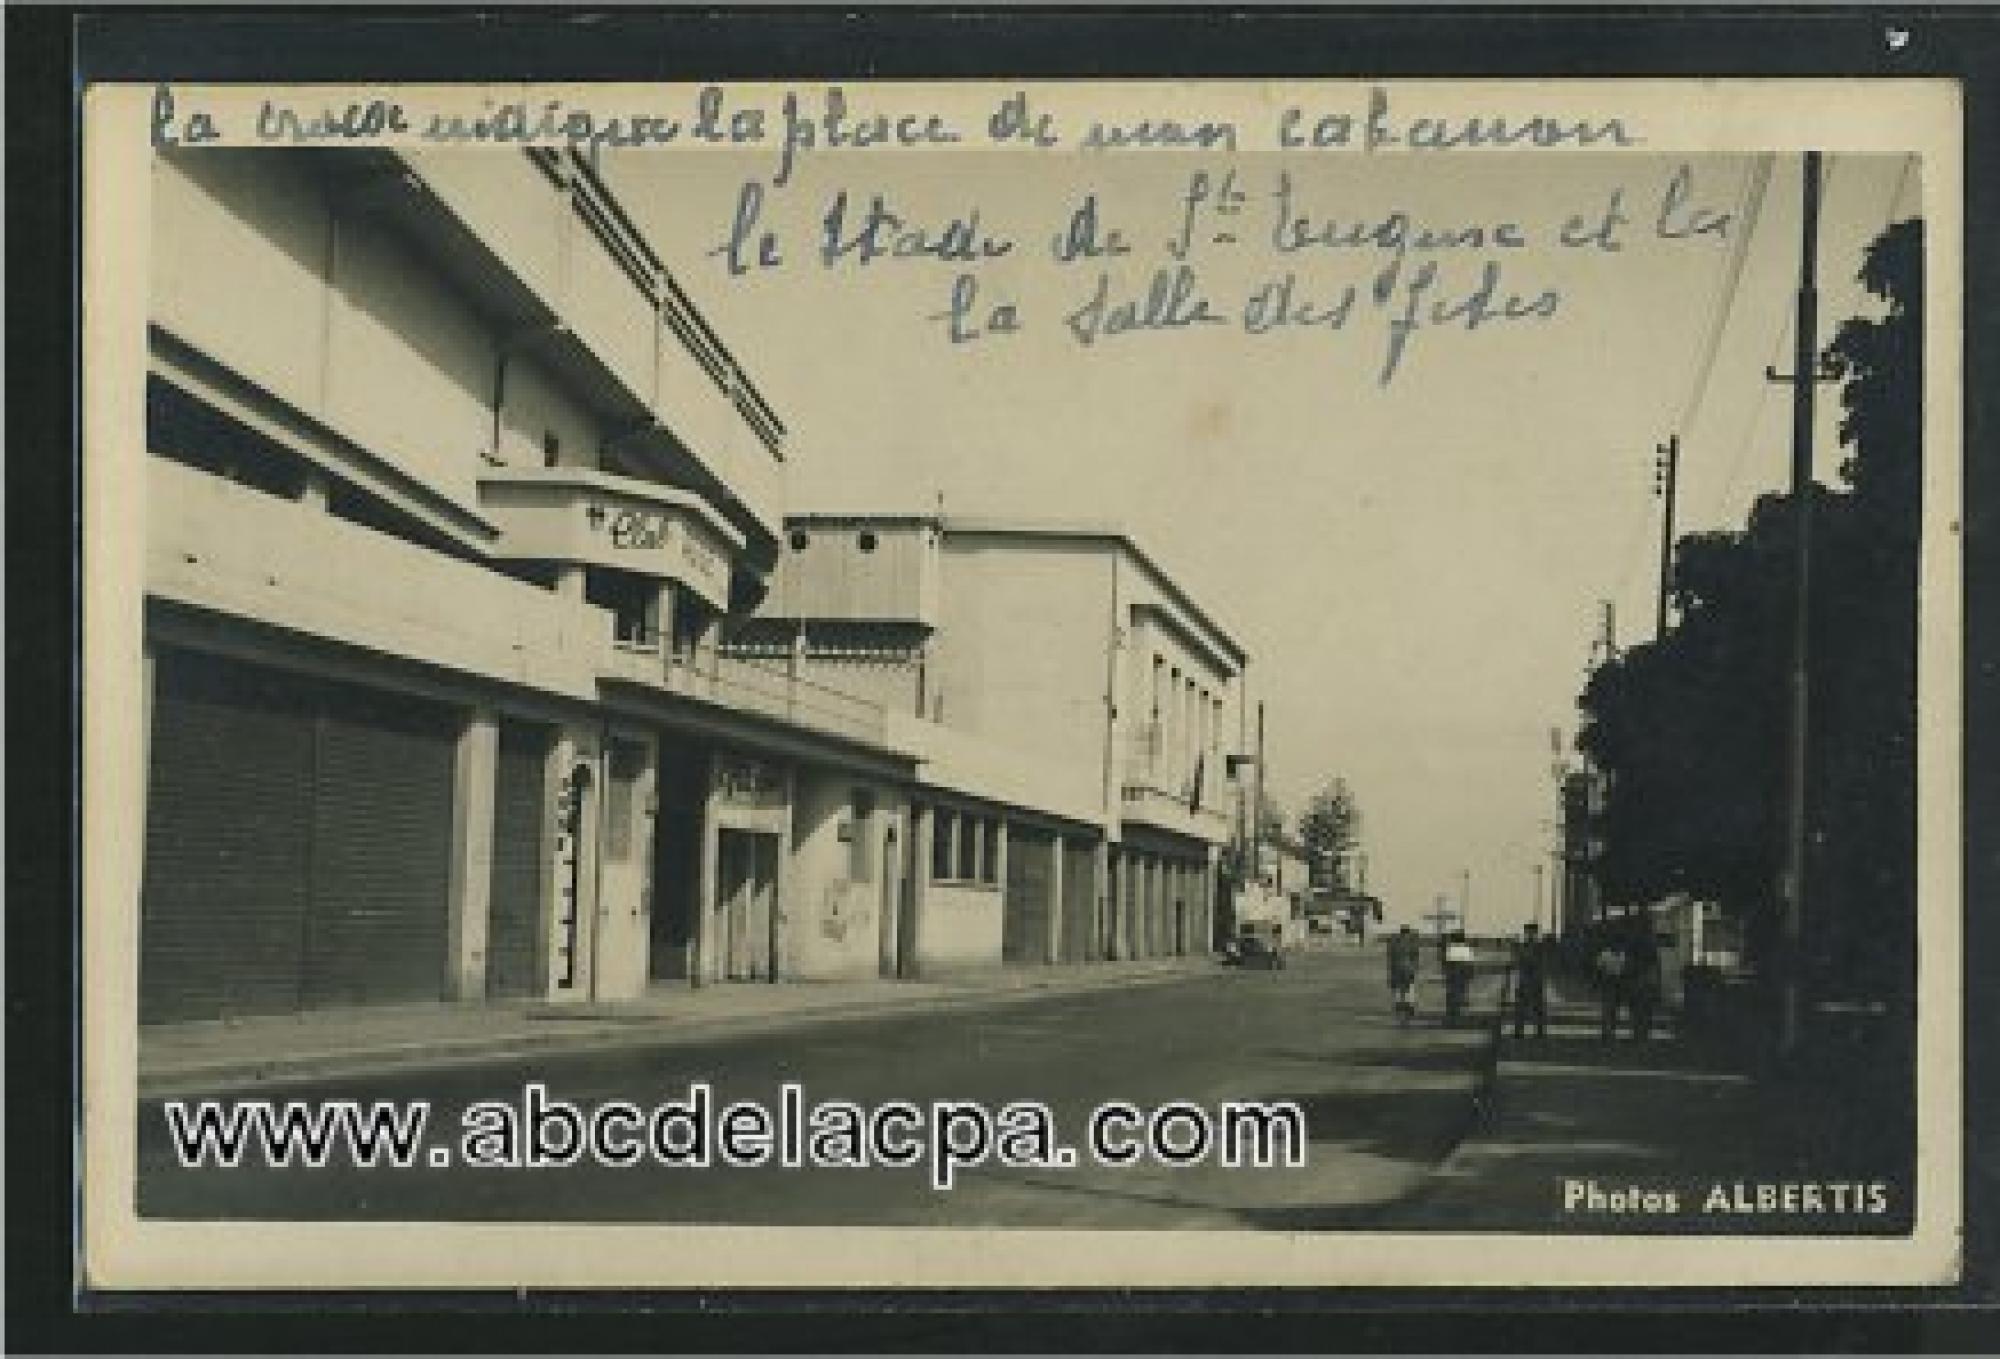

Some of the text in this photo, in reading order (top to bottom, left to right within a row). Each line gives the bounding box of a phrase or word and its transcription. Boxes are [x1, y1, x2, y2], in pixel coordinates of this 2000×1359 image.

[691, 86, 765, 142] la
[772, 90, 961, 188] place
[988, 91, 1058, 147] de
[1082, 120, 1237, 151] mon
[1281, 87, 1640, 153] cabanon
[706, 182, 780, 276] le
[1052, 196, 1132, 262] de
[1561, 187, 1628, 252] et
[1656, 163, 1734, 240] la
[926, 272, 1022, 344] la
[1244, 272, 1356, 335] des
